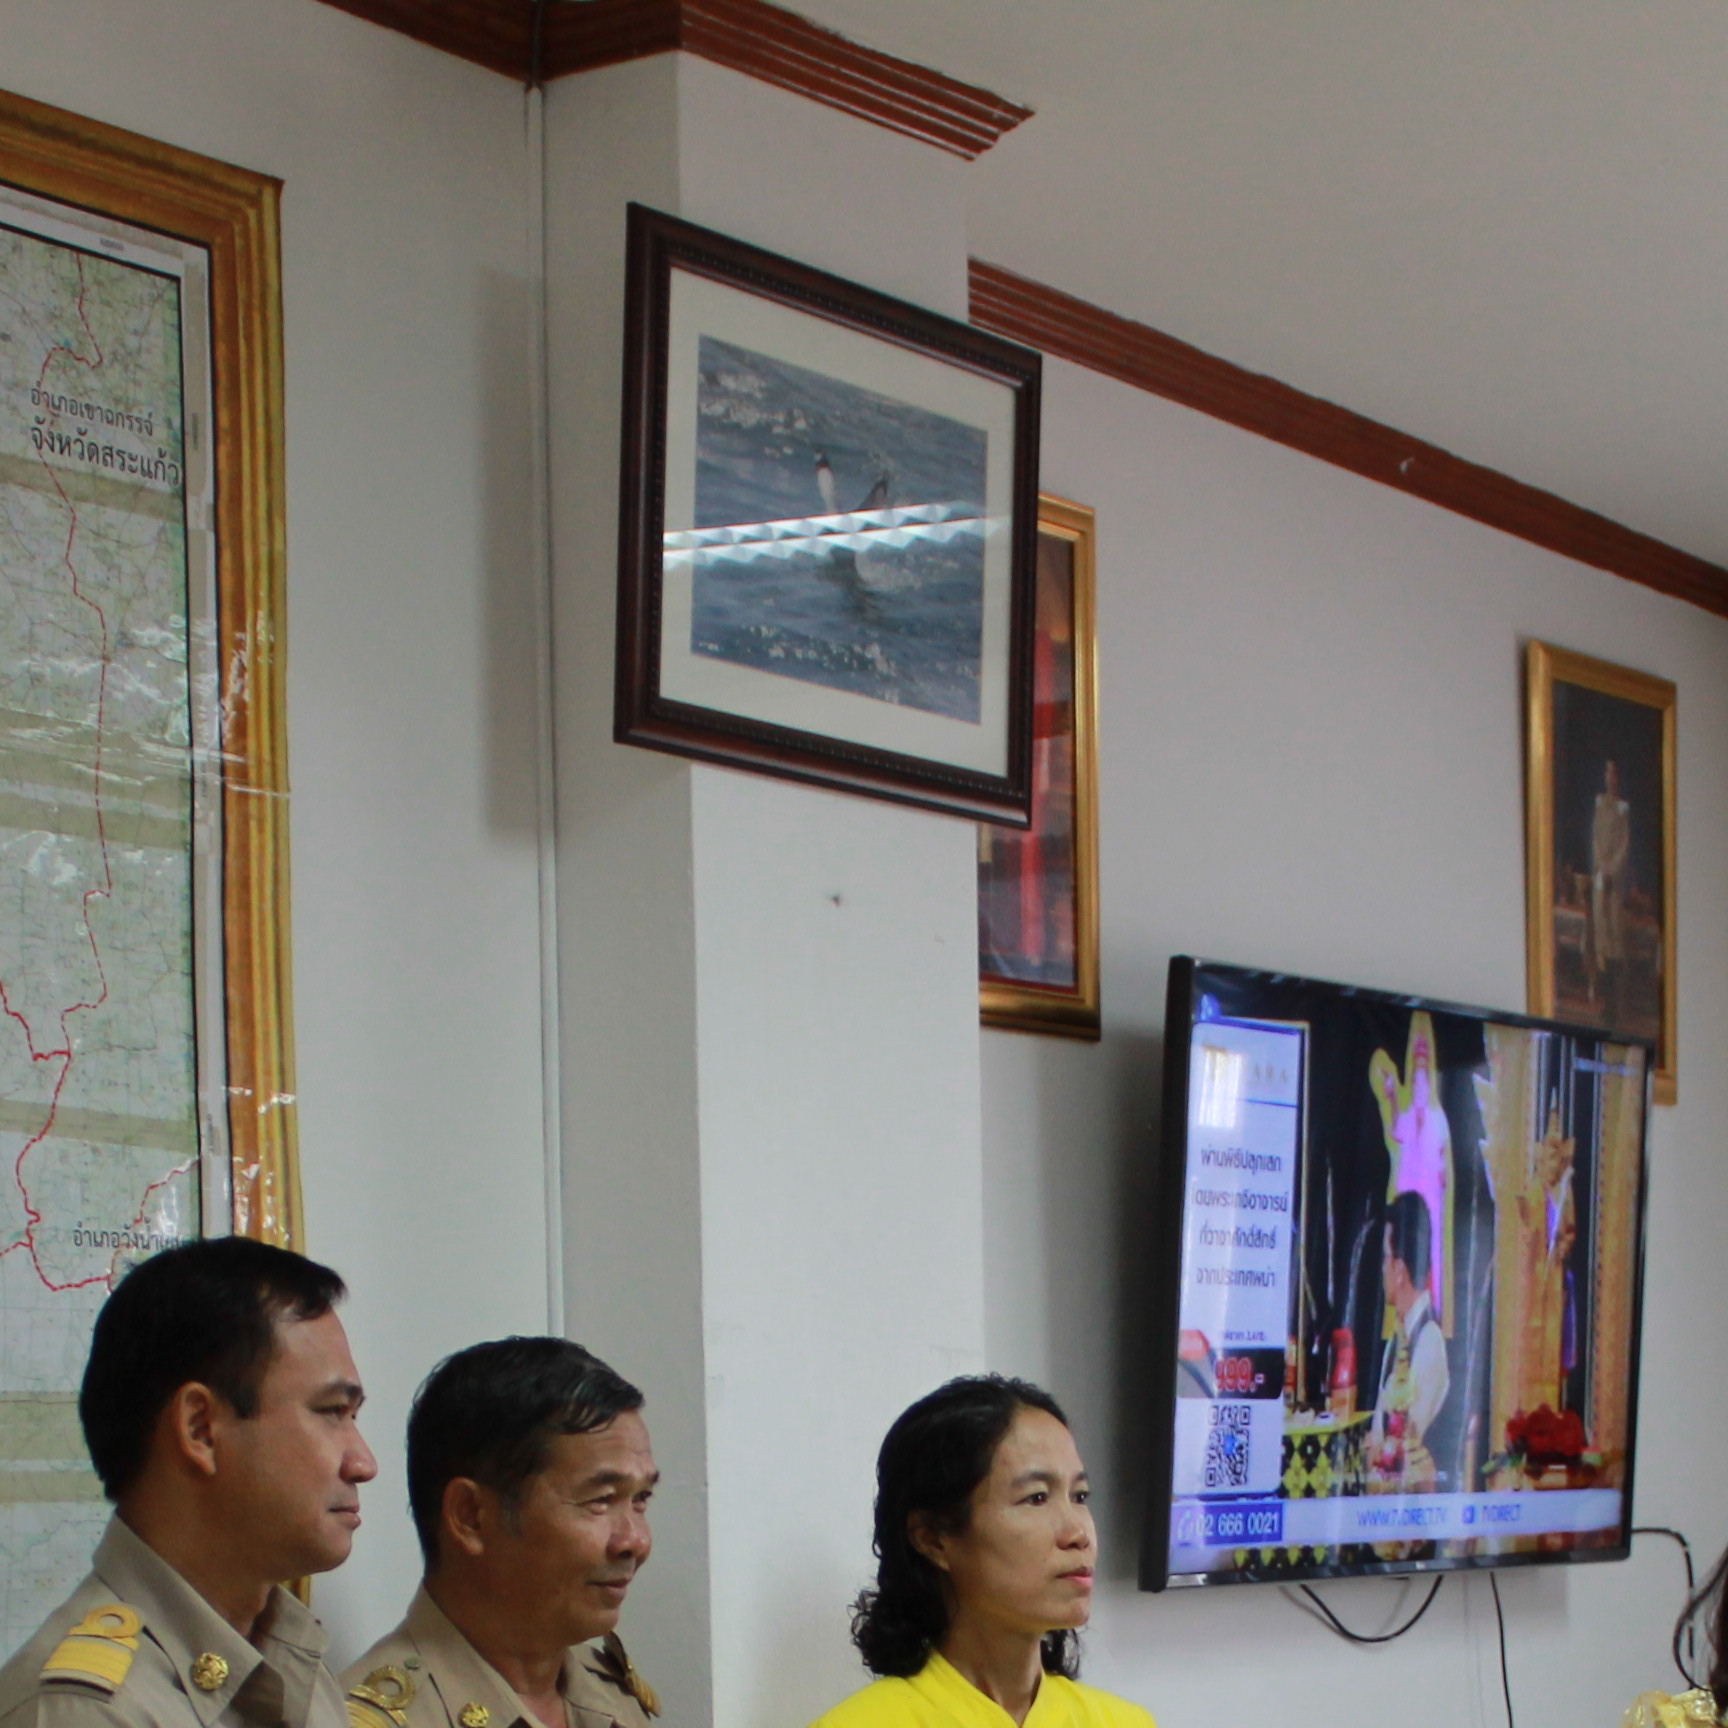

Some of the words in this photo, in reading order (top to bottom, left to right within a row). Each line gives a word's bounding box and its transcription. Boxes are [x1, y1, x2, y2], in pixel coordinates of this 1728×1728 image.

[30, 381, 153, 437] อำเภอเขาฉกรรจ์
[30, 416, 181, 486] จังหวัดสระแก้ว
[1195, 1513, 1214, 1537] 02
[1218, 1512, 1244, 1536] 666
[1248, 1511, 1280, 1535] 0021
